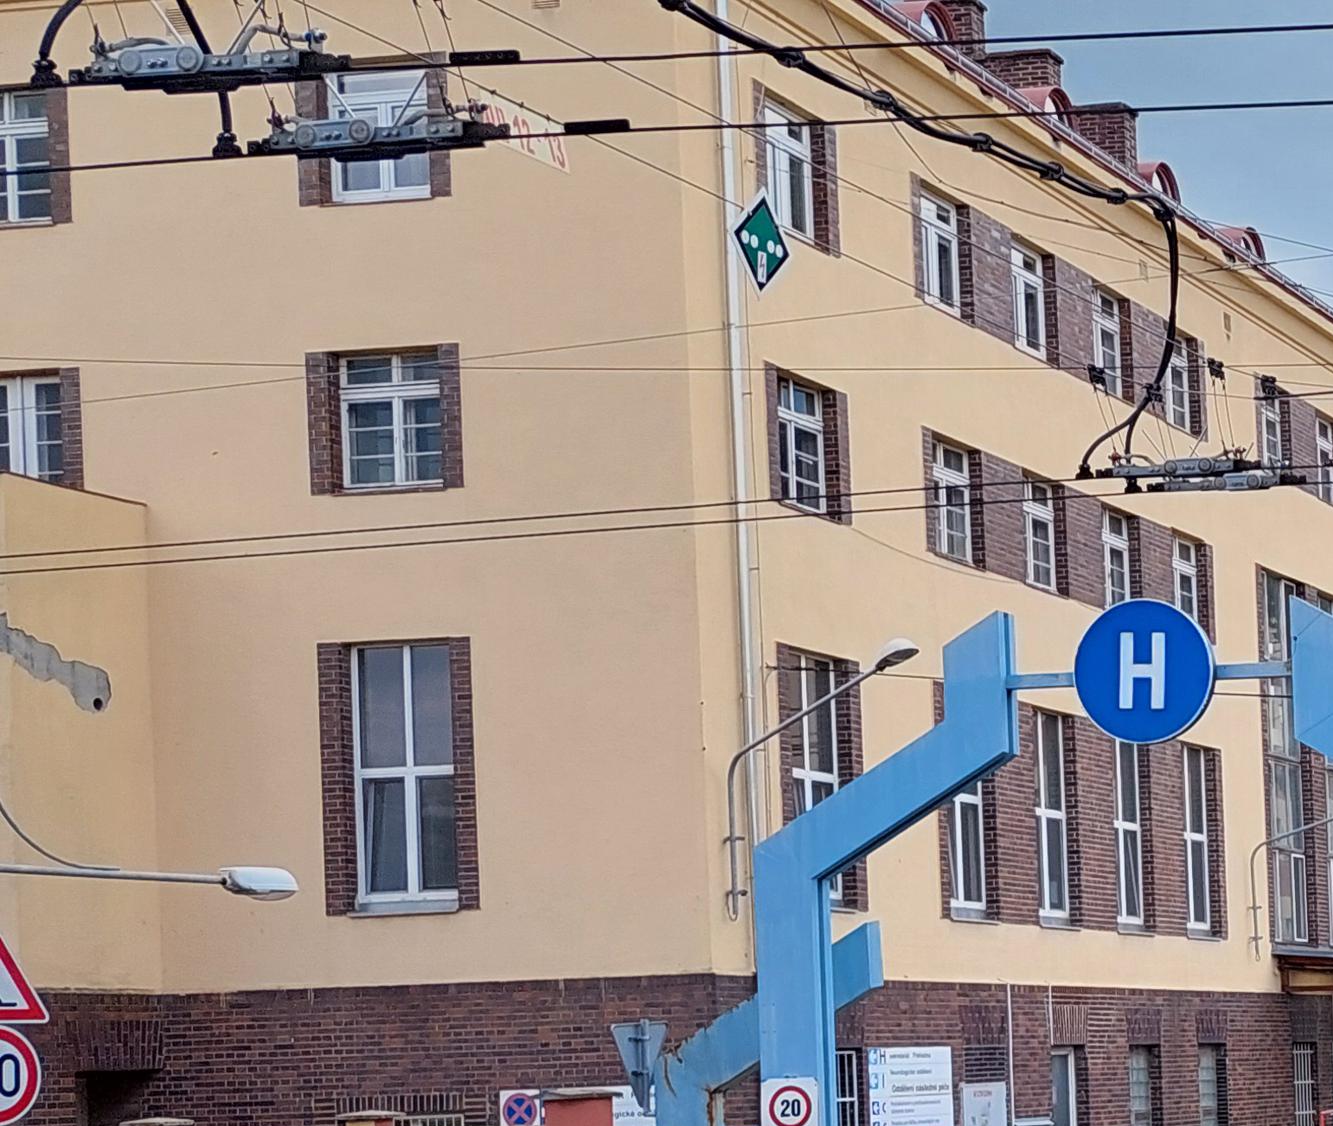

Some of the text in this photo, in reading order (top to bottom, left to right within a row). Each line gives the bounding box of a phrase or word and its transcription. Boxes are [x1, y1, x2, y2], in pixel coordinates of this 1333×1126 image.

[1119, 632, 1165, 709] H
[0, 1054, 20, 1097] 0
[780, 1099, 801, 1117] 20
